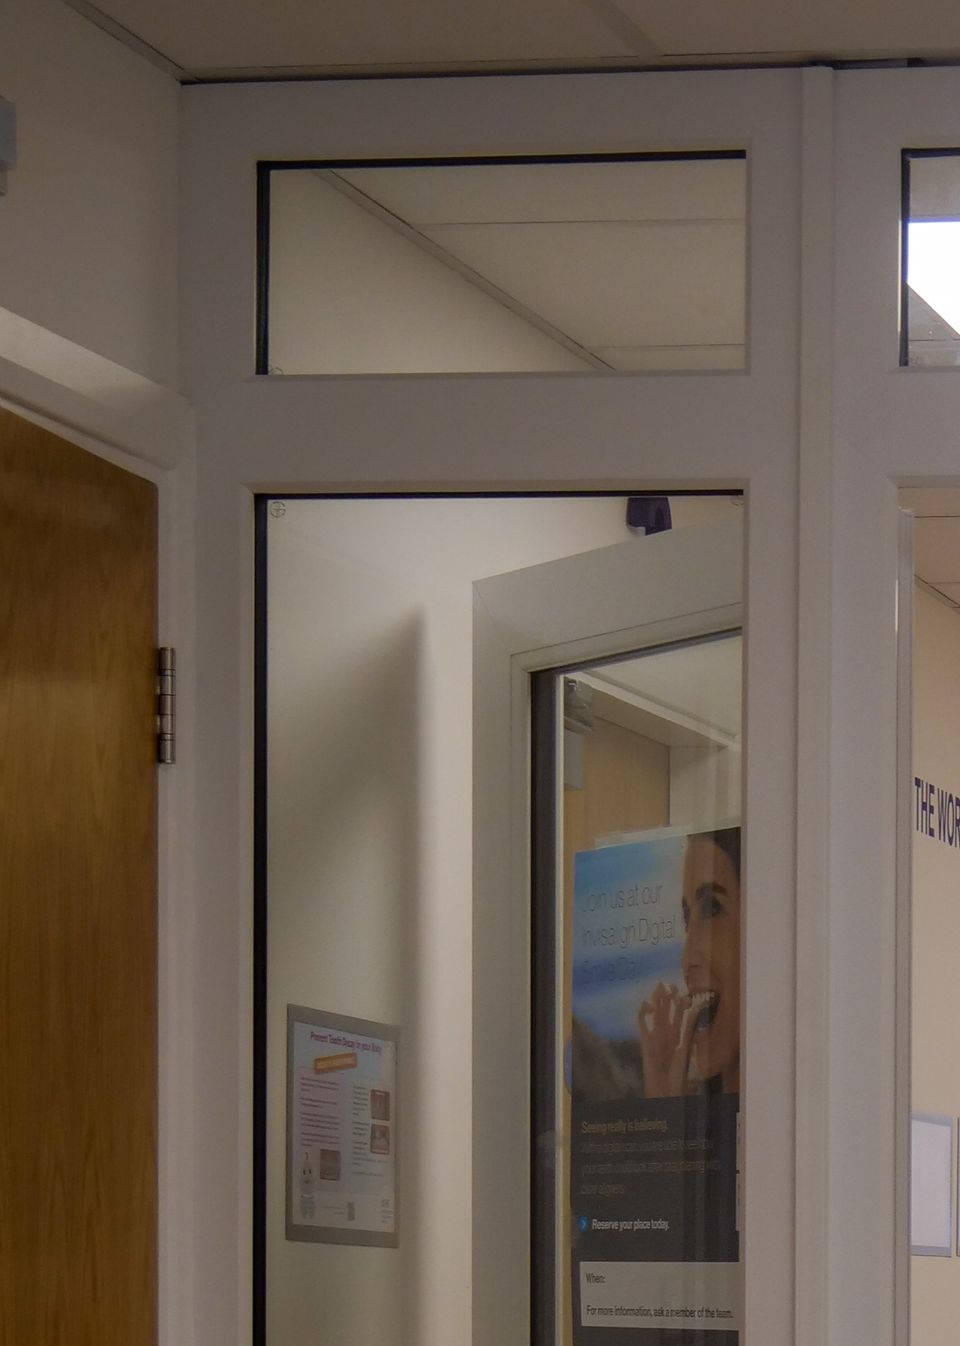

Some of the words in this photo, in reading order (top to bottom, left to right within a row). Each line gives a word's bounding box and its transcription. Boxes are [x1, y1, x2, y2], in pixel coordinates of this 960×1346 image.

[914, 777, 935, 837] THE
[641, 885, 663, 904] our
[639, 914, 676, 945] Digital
[592, 1218, 619, 1230] Reserve
[619, 1221, 633, 1231] your
[634, 1219, 650, 1231] place
[651, 1219, 670, 1231] today.
[586, 1272, 605, 1283] When:
[587, 1305, 597, 1315] For
[598, 1307, 613, 1316] more
[614, 1305, 652, 1317] information,
[653, 1306, 664, 1316] ask
[670, 1307, 695, 1318] member
[697, 1307, 704, 1318] of
[705, 1307, 715, 1318] the
